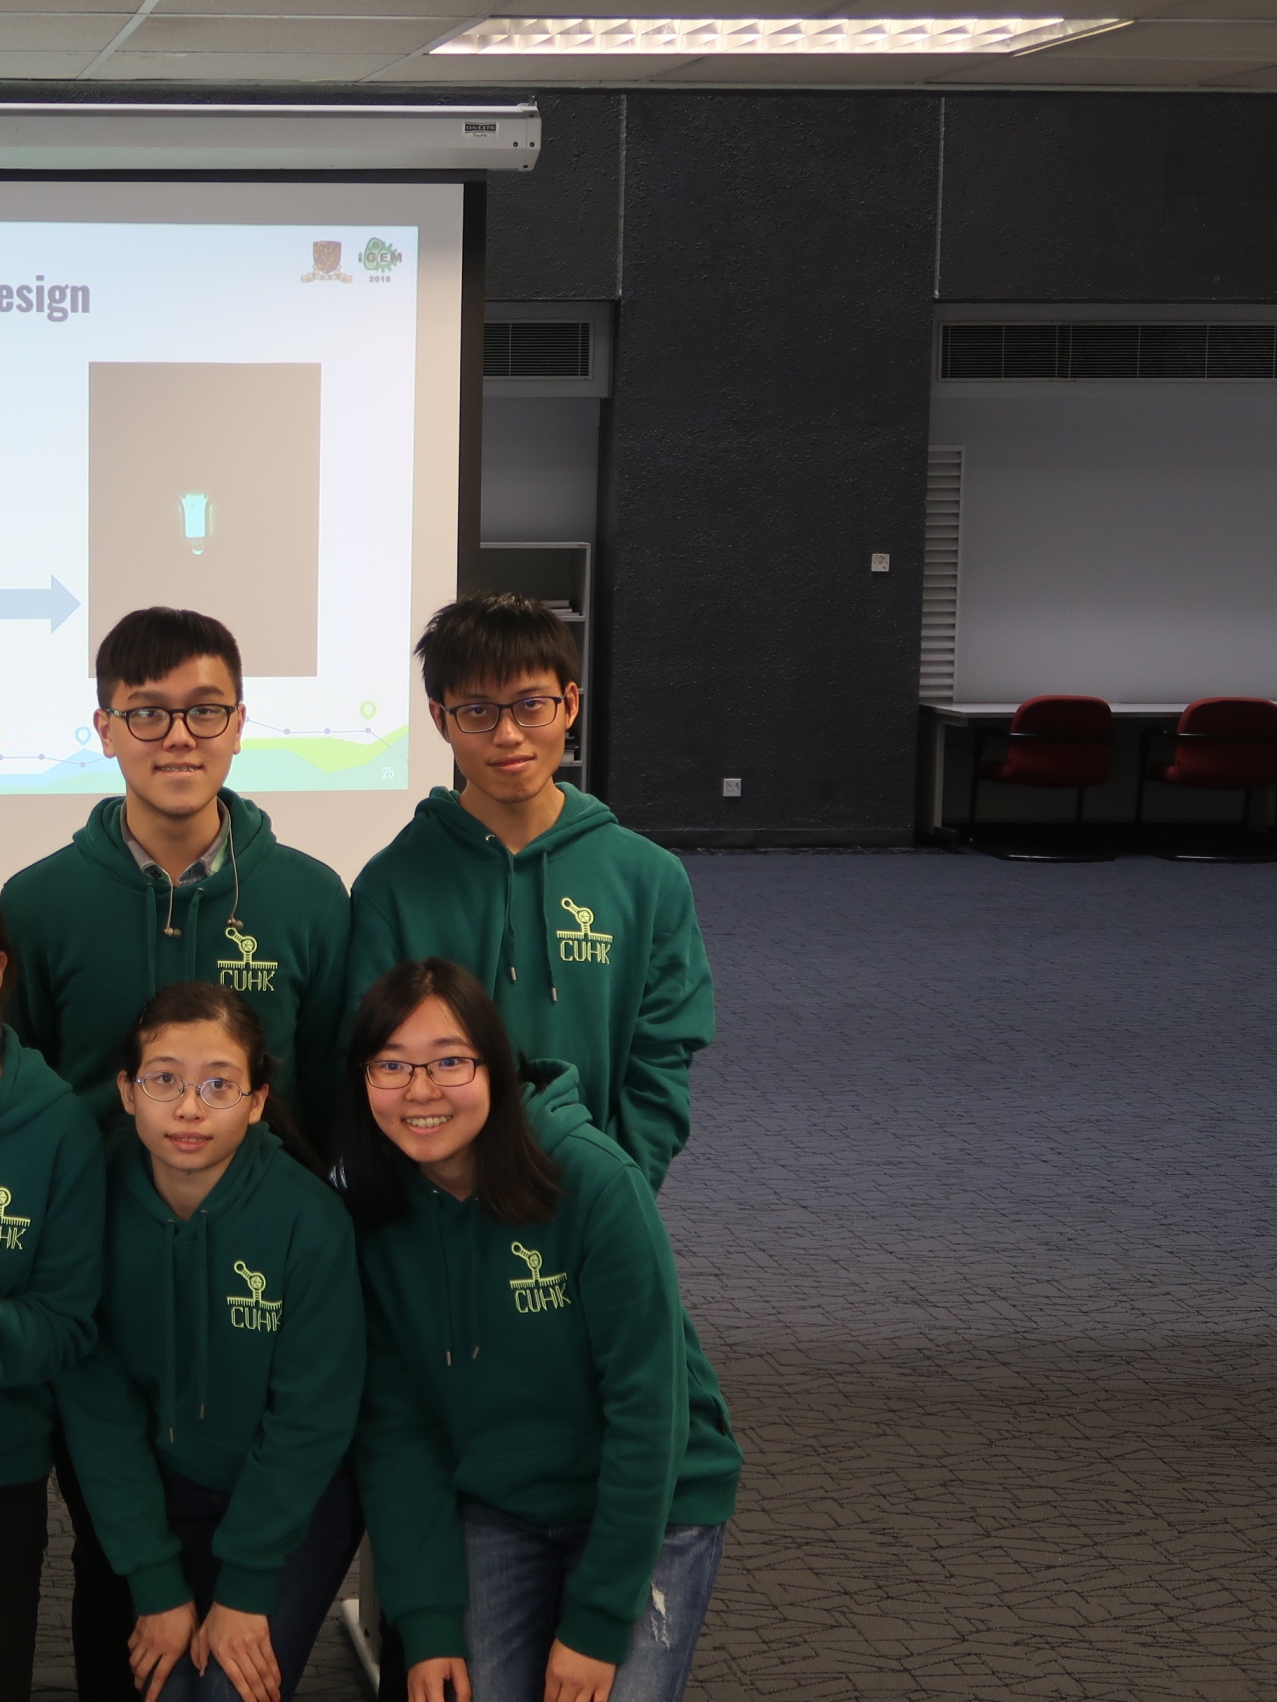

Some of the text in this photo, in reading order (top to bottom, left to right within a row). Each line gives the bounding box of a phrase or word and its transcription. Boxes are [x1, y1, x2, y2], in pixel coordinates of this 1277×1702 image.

[382, 766, 395, 779] 25
[560, 940, 612, 965] CUHK
[220, 969, 276, 992] CUHK
[514, 1282, 573, 1314] CUHK
